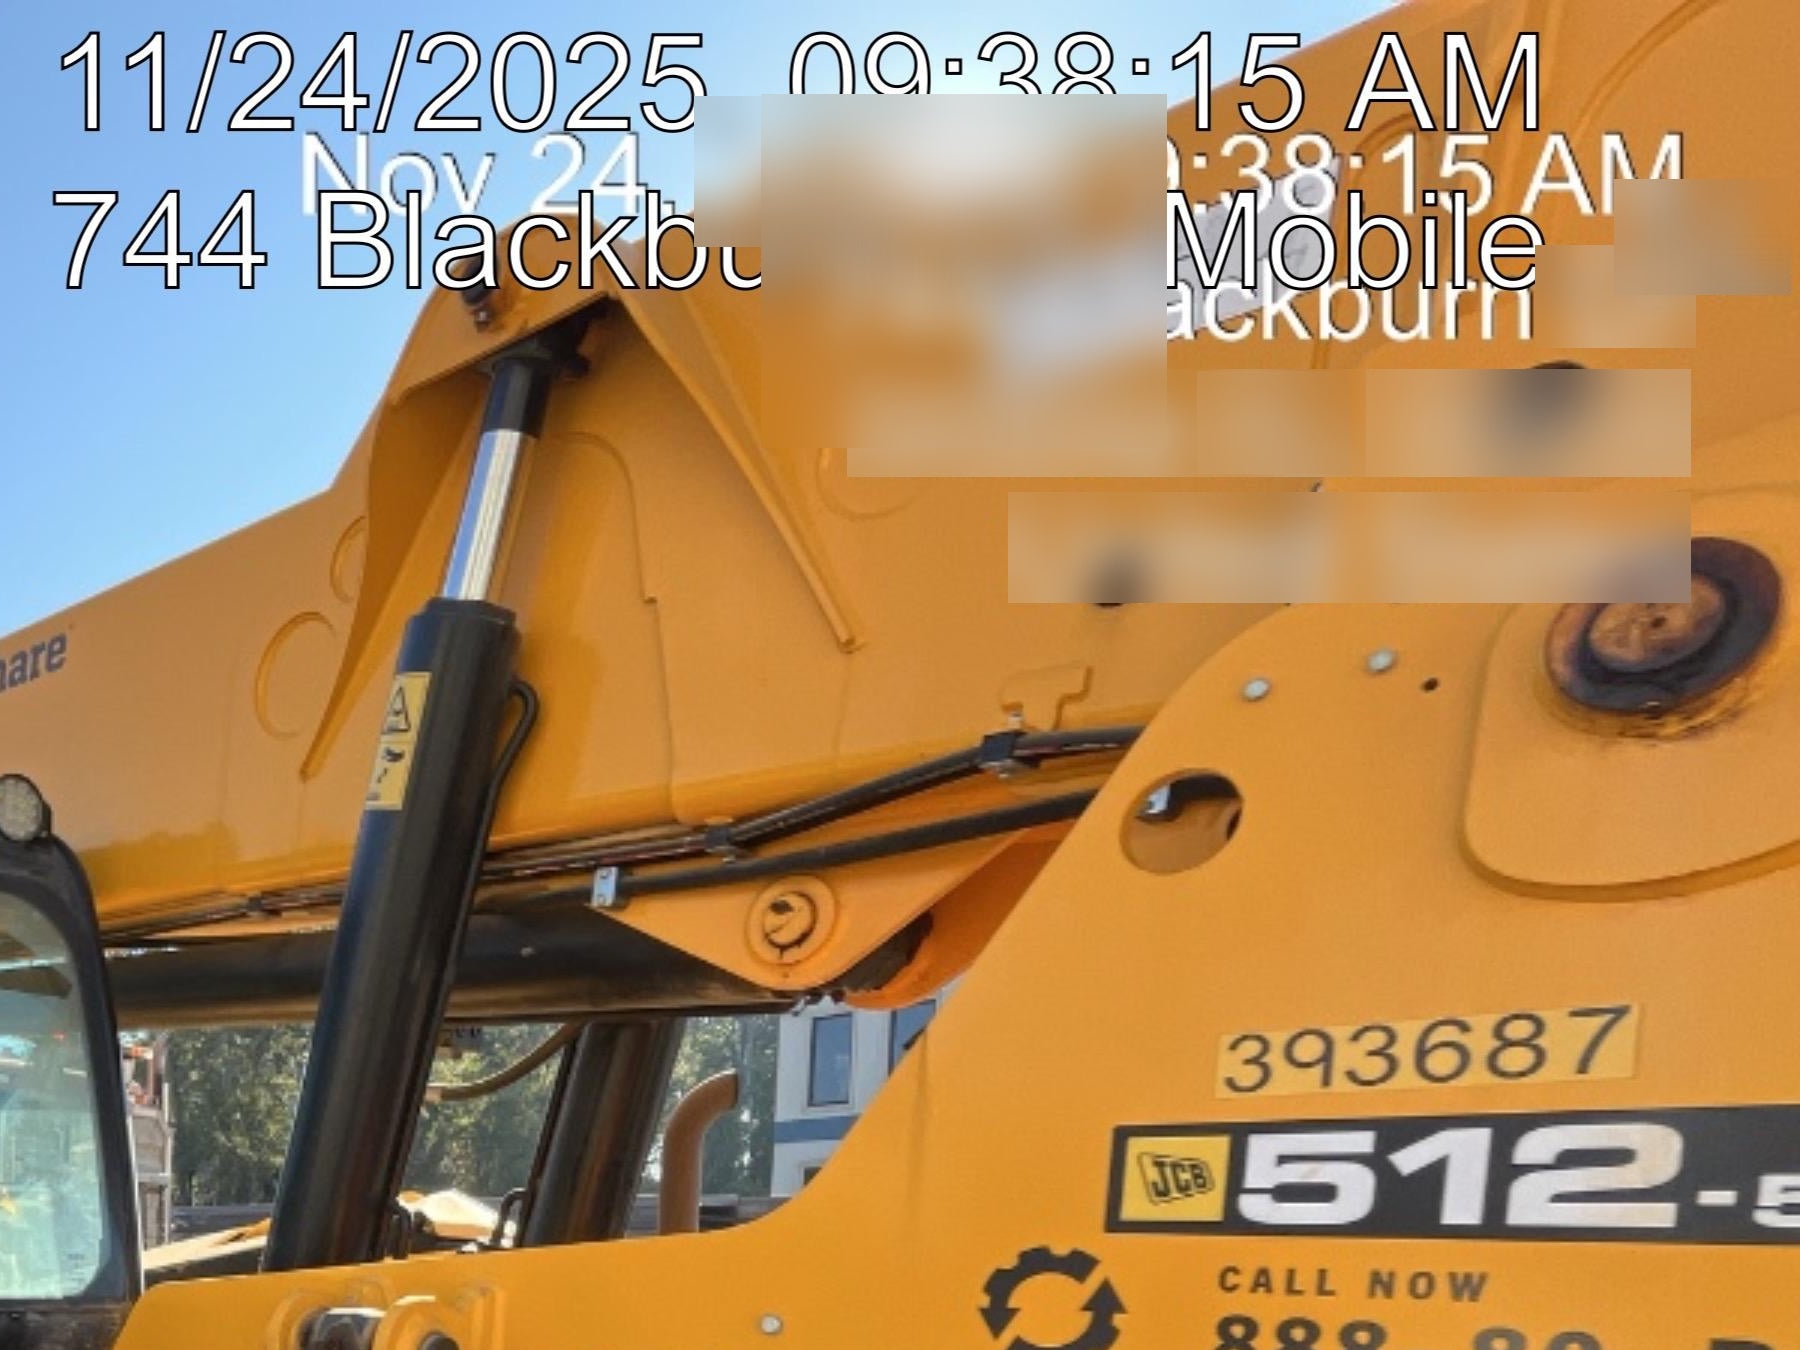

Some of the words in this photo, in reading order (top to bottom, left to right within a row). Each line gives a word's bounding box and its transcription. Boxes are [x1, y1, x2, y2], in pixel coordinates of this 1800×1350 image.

[1223, 1003, 1632, 1094] 393687
[1147, 1157, 1211, 1202] JCB
[1218, 1264, 1338, 1299] CALL
[1367, 1269, 1490, 1303] NOW
